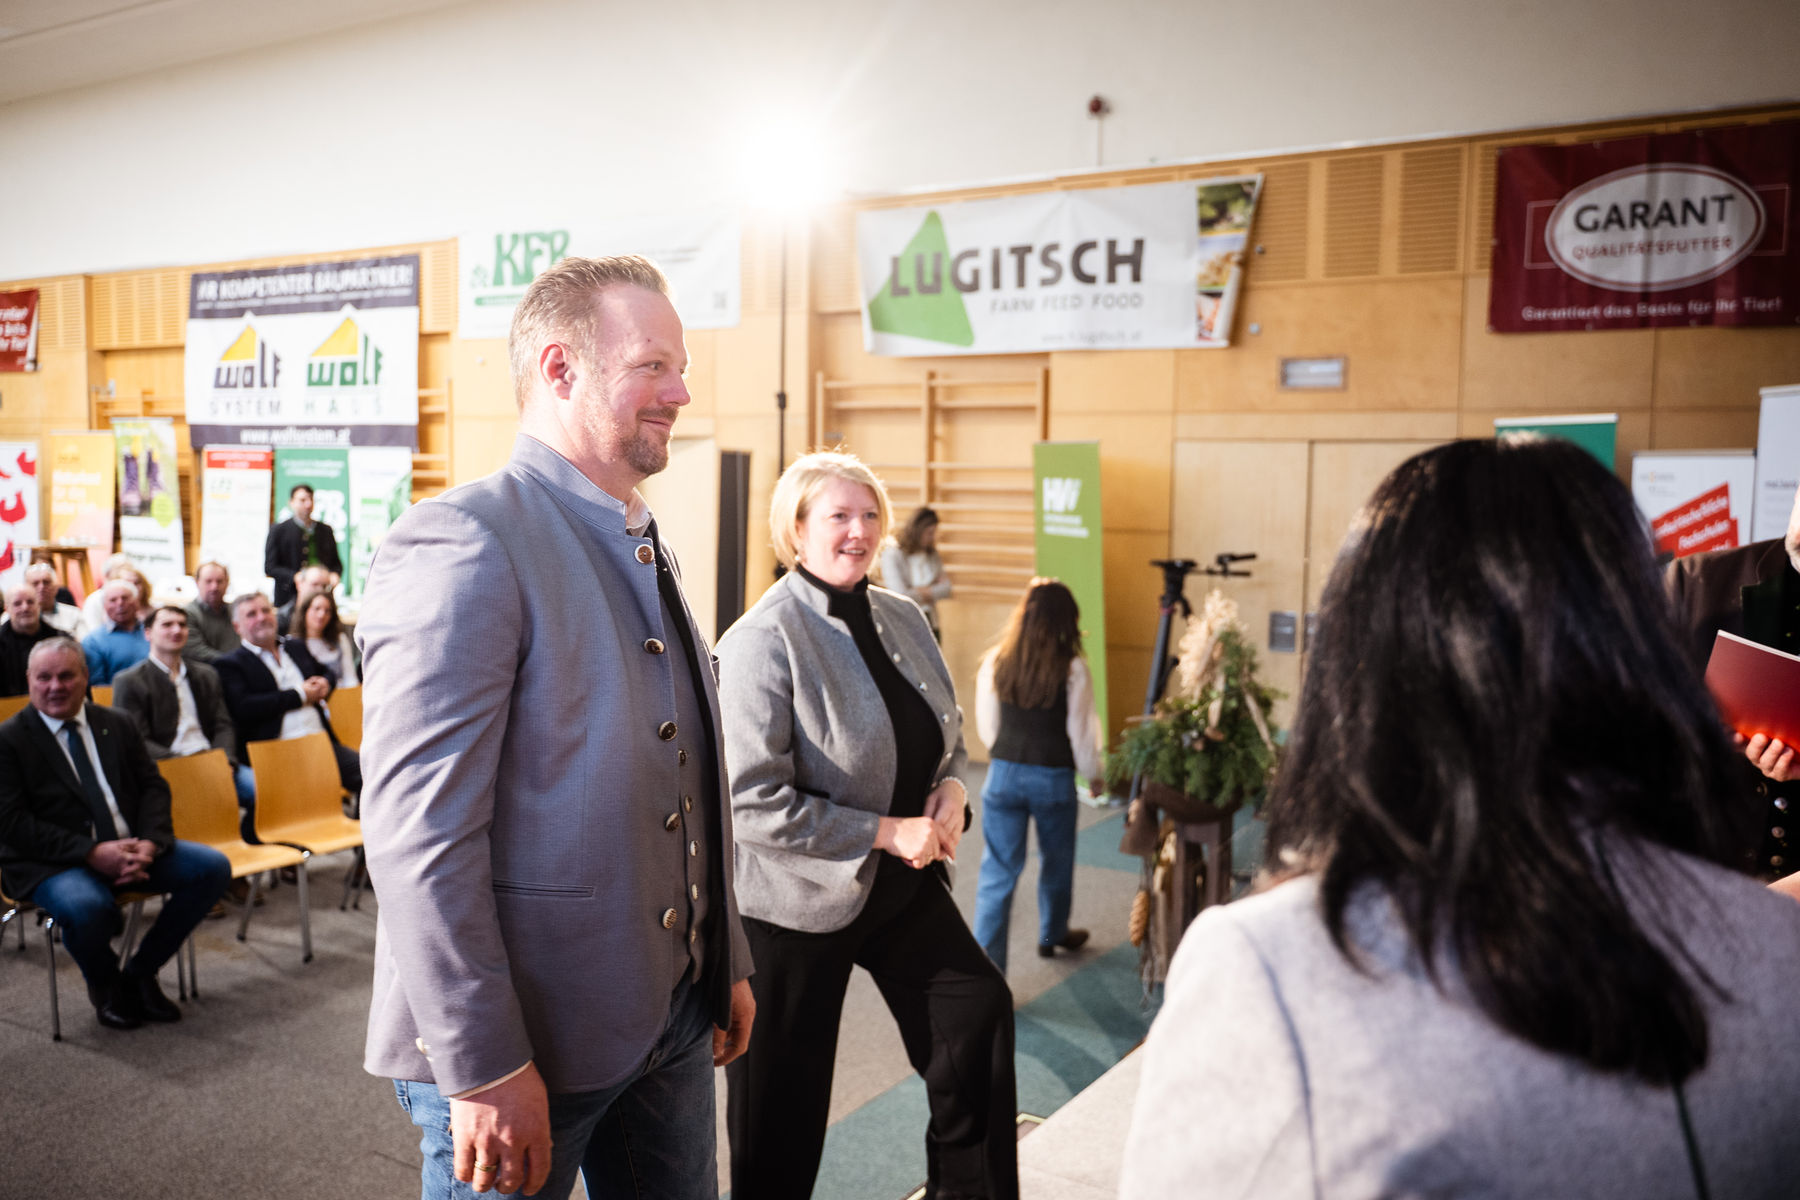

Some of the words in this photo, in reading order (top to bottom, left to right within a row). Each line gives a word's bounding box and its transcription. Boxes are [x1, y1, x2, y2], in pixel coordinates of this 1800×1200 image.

[1574, 194, 1735, 233] GARANT
[890, 238, 1145, 297] LUGITSCH
[990, 295, 1034, 314] FARM
[1042, 294, 1082, 312] FEED
[1091, 292, 1144, 310] FOOD
[1521, 306, 1601, 321] Garantiert
[213, 338, 281, 388] wolf
[306, 333, 383, 387] wolf
